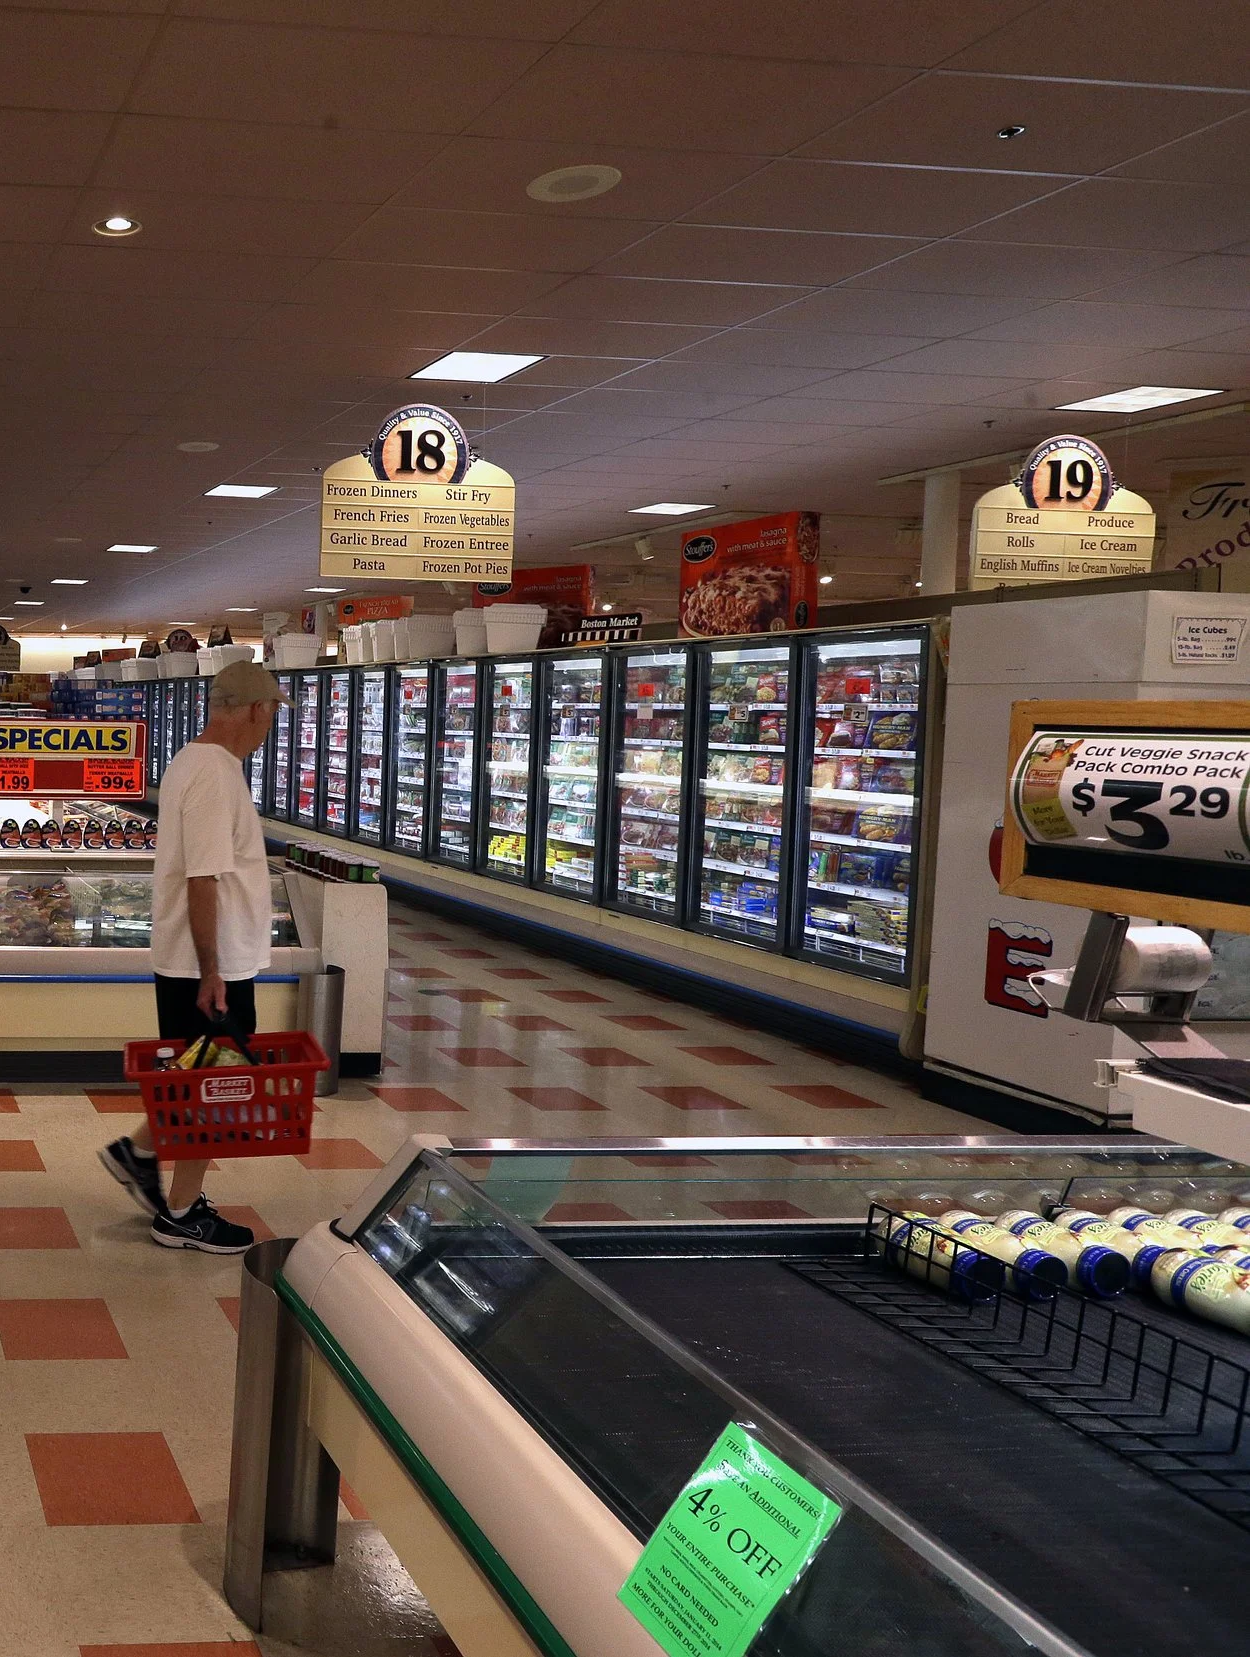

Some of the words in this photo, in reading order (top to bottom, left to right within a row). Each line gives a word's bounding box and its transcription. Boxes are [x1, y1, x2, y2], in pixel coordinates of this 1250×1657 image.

[378, 417, 399, 441] Quality
[408, 409, 430, 417] Value
[431, 411, 450, 427] Since
[450, 425, 463, 445] 1917
[396, 429, 446, 473] 18
[1044, 459, 1093, 502] 19
[327, 484, 367, 497] Frozen
[371, 485, 417, 499] Dinners
[445, 488, 467, 501] Stir
[472, 490, 491, 504] Fry
[334, 508, 375, 521] French
[380, 510, 409, 523] Fries
[424, 512, 456, 525] Frozen
[460, 513, 510, 528] Vegetables
[1006, 512, 1039, 525] Bread
[1087, 516, 1134, 529] Produce
[330, 532, 367, 546] Garlic
[371, 534, 407, 547] Bread
[760, 527, 787, 538] lasagna
[423, 536, 465, 549] Frozen
[469, 538, 509, 551] Entree
[727, 542, 742, 553] with
[742, 541, 759, 550] meat
[766, 536, 787, 546] sauce
[1007, 536, 1035, 548] Rolls
[1080, 539, 1097, 551] Ice
[1100, 540, 1137, 552] Cream
[353, 558, 385, 571] Pasta
[422, 561, 460, 573] Frozen
[464, 561, 482, 574] Pot
[485, 562, 508, 575] Pies
[980, 558, 1017, 573] English
[1020, 559, 1059, 573] Muffins
[1068, 562, 1079, 573] Ice
[1082, 562, 1107, 574] Cream
[1109, 563, 1146, 575] Novelties
[367, 606, 389, 616] PIZZA
[581, 617, 608, 629] Boston
[609, 615, 638, 628] Market
[1203, 626, 1228, 634] Cubes
[1085, 745, 1113, 757] Cut
[1120, 746, 1183, 762] Veggie
[1187, 748, 1250, 762] Snack
[1074, 760, 1116, 775] Pack
[1121, 762, 1188, 777] Combo
[1192, 764, 1244, 779] Pack
[95, 776, 136, 791] .99¢
[208, 1079, 249, 1088] MARKET
[210, 1087, 248, 1096] BASKET
[726, 1439, 754, 1464] THANK
[737, 1481, 752, 1493] AN
[749, 1490, 802, 1537] ADDITIONAL
[688, 1487, 727, 1533] 4%
[726, 1528, 783, 1580] OFF
[666, 1521, 687, 1544] YOUR
[685, 1541, 711, 1568] ENTIRE
[660, 1564, 672, 1578] NO
[671, 1576, 691, 1598] CARD
[690, 1595, 719, 1627] NEEDED
[632, 1582, 652, 1605] MORE
[650, 1602, 665, 1620] FOR
[664, 1616, 684, 1640] YOUR
[684, 1609, 707, 1633] JANUARY
